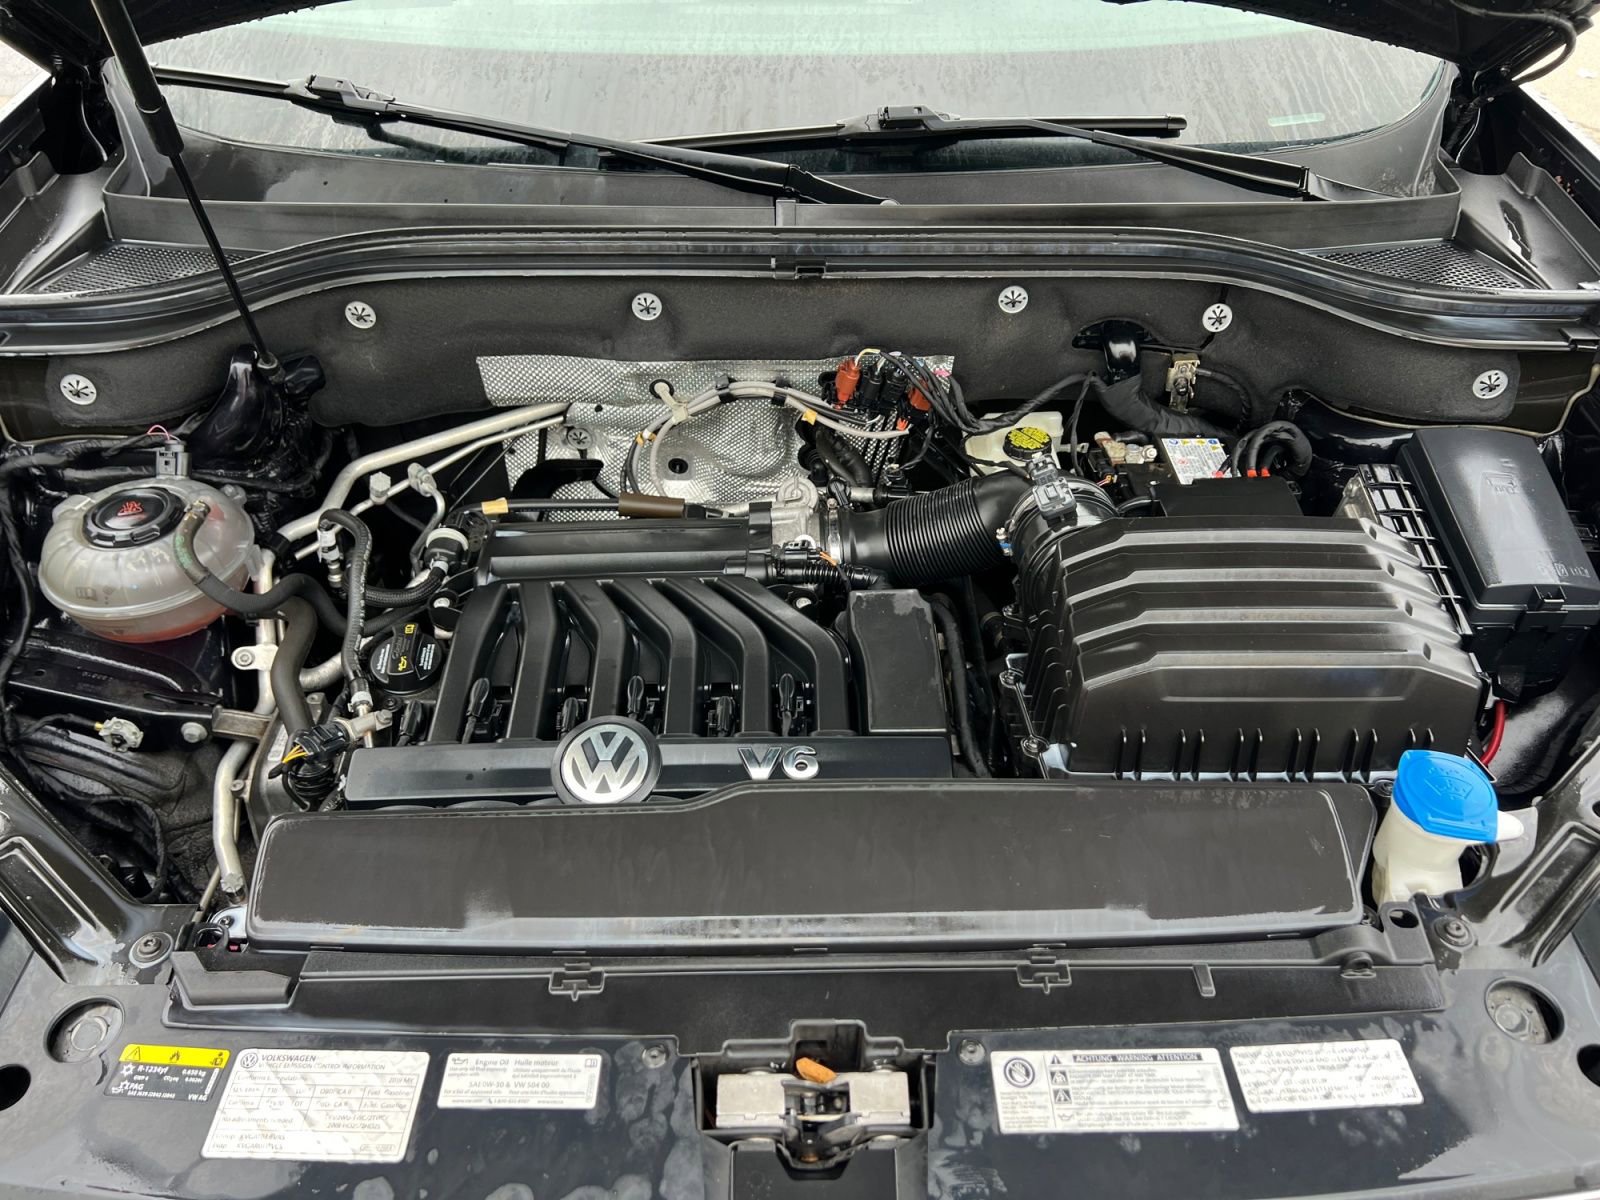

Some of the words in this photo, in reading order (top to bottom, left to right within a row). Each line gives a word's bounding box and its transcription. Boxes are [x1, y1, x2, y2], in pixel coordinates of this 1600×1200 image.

[738, 745, 820, 780] V6
[261, 1054, 317, 1062] VOLKSWAGEN
[1076, 1054, 1112, 1063] ACHTUNG
[1116, 1053, 1154, 1062] WARNING
[1156, 1052, 1198, 1061] ATTENTION
[475, 1058, 498, 1067] Engine
[499, 1058, 510, 1066] Oil
[514, 1058, 532, 1066] Huile
[137, 1064, 170, 1075] R-1234yf
[198, 1069, 207, 1077] kg
[128, 1083, 145, 1091] PAG
[514, 1081, 526, 1089] VW
[187, 1093, 199, 1101] VW
